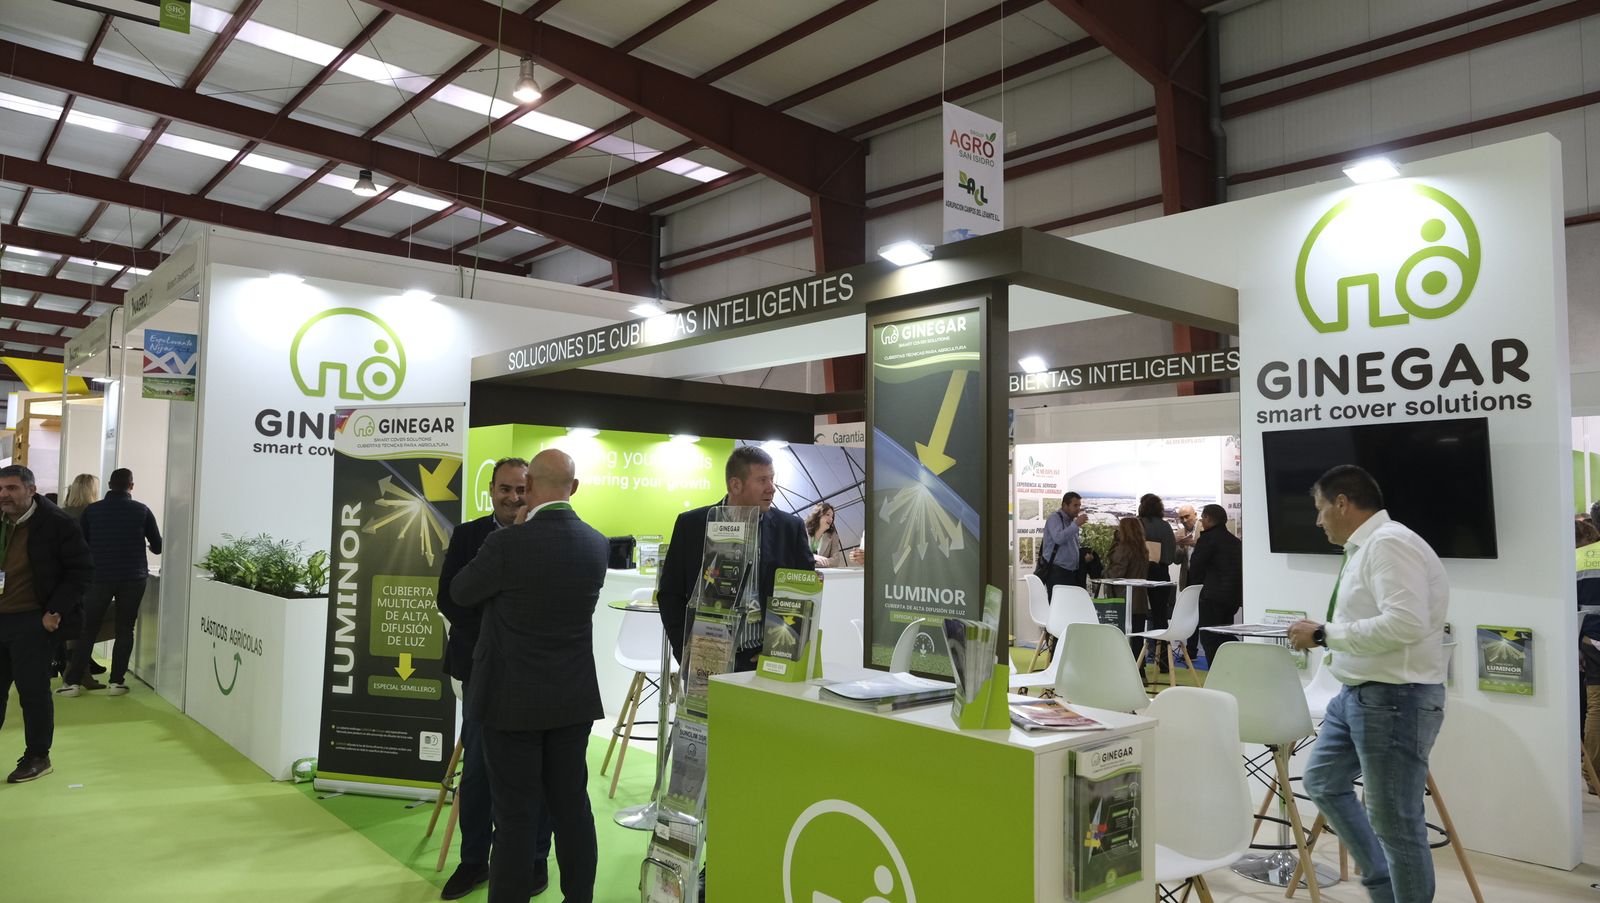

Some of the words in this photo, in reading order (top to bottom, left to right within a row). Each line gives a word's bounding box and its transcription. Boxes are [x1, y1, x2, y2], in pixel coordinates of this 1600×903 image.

[950, 129, 995, 159] AGRO
[958, 149, 972, 161] SAN
[972, 154, 995, 168] ISIDRO
[508, 335, 584, 371] SOLUCIONES
[587, 330, 606, 353] DE
[703, 272, 854, 330] INTELIGENTES
[901, 316, 967, 340] GINEGAR
[1088, 351, 1240, 385] INTELIGENTES
[1257, 338, 1530, 400] GINEGAR
[1256, 403, 1322, 424] smart
[1329, 400, 1396, 420] cover
[1405, 390, 1532, 415] solutions
[254, 408, 335, 440] GIN
[378, 417, 455, 434] GINEGAR
[252, 443, 303, 455] smart
[633, 478, 662, 491] your
[786, 573, 816, 582] GINEGAR
[332, 501, 362, 695] LUMINOR
[382, 585, 434, 597] CUBIERTA
[884, 583, 967, 606] LUMINOR
[377, 598, 438, 610] MULTICAPA
[779, 601, 802, 609] GINEGAR
[385, 610, 399, 621] DE
[401, 611, 430, 622] ALTA
[200, 616, 228, 642] PLÁSTICOS
[229, 628, 263, 656] AGRÍCOLAS
[381, 621, 433, 635] DIFUSIÓN
[387, 635, 401, 646] DE
[404, 636, 426, 648] LUZ
[1486, 664, 1522, 673] LUMINOR
[373, 682, 400, 691] ESPECIAL
[400, 684, 436, 694] SEMILLEROS
[1101, 746, 1133, 762] GINEGAR
